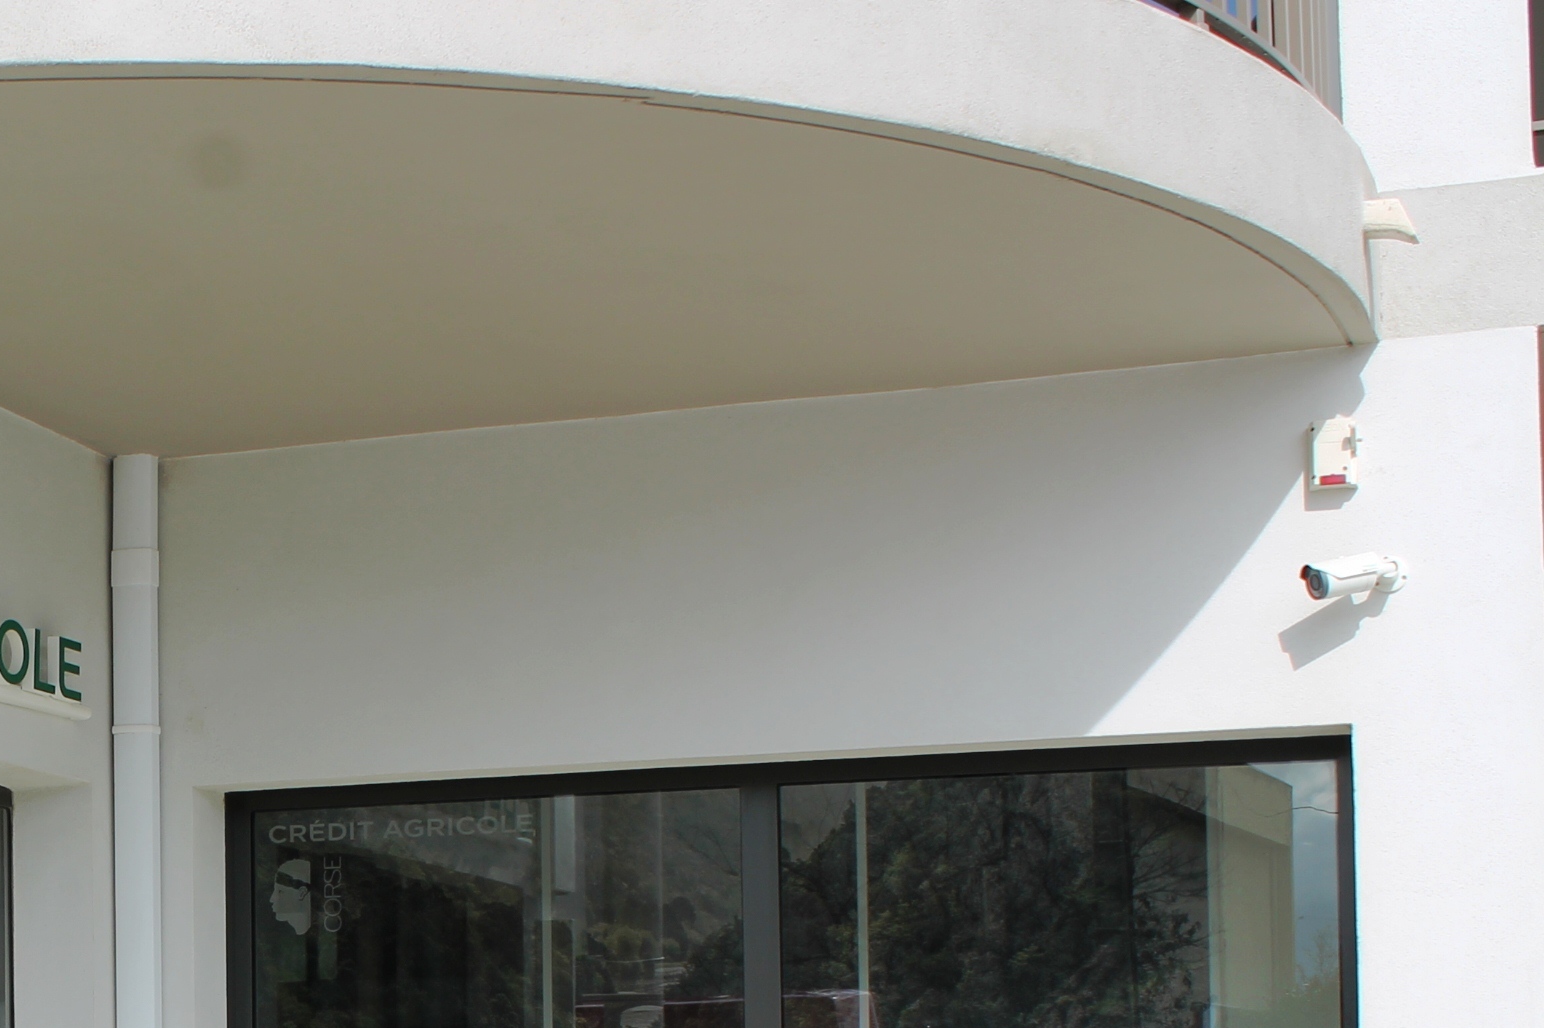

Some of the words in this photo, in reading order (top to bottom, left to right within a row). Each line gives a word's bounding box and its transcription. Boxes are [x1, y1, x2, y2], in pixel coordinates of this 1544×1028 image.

[268, 819, 374, 844] CRÉDIT
[382, 814, 534, 840] AGRICOLE
[323, 856, 343, 933] CORSE
